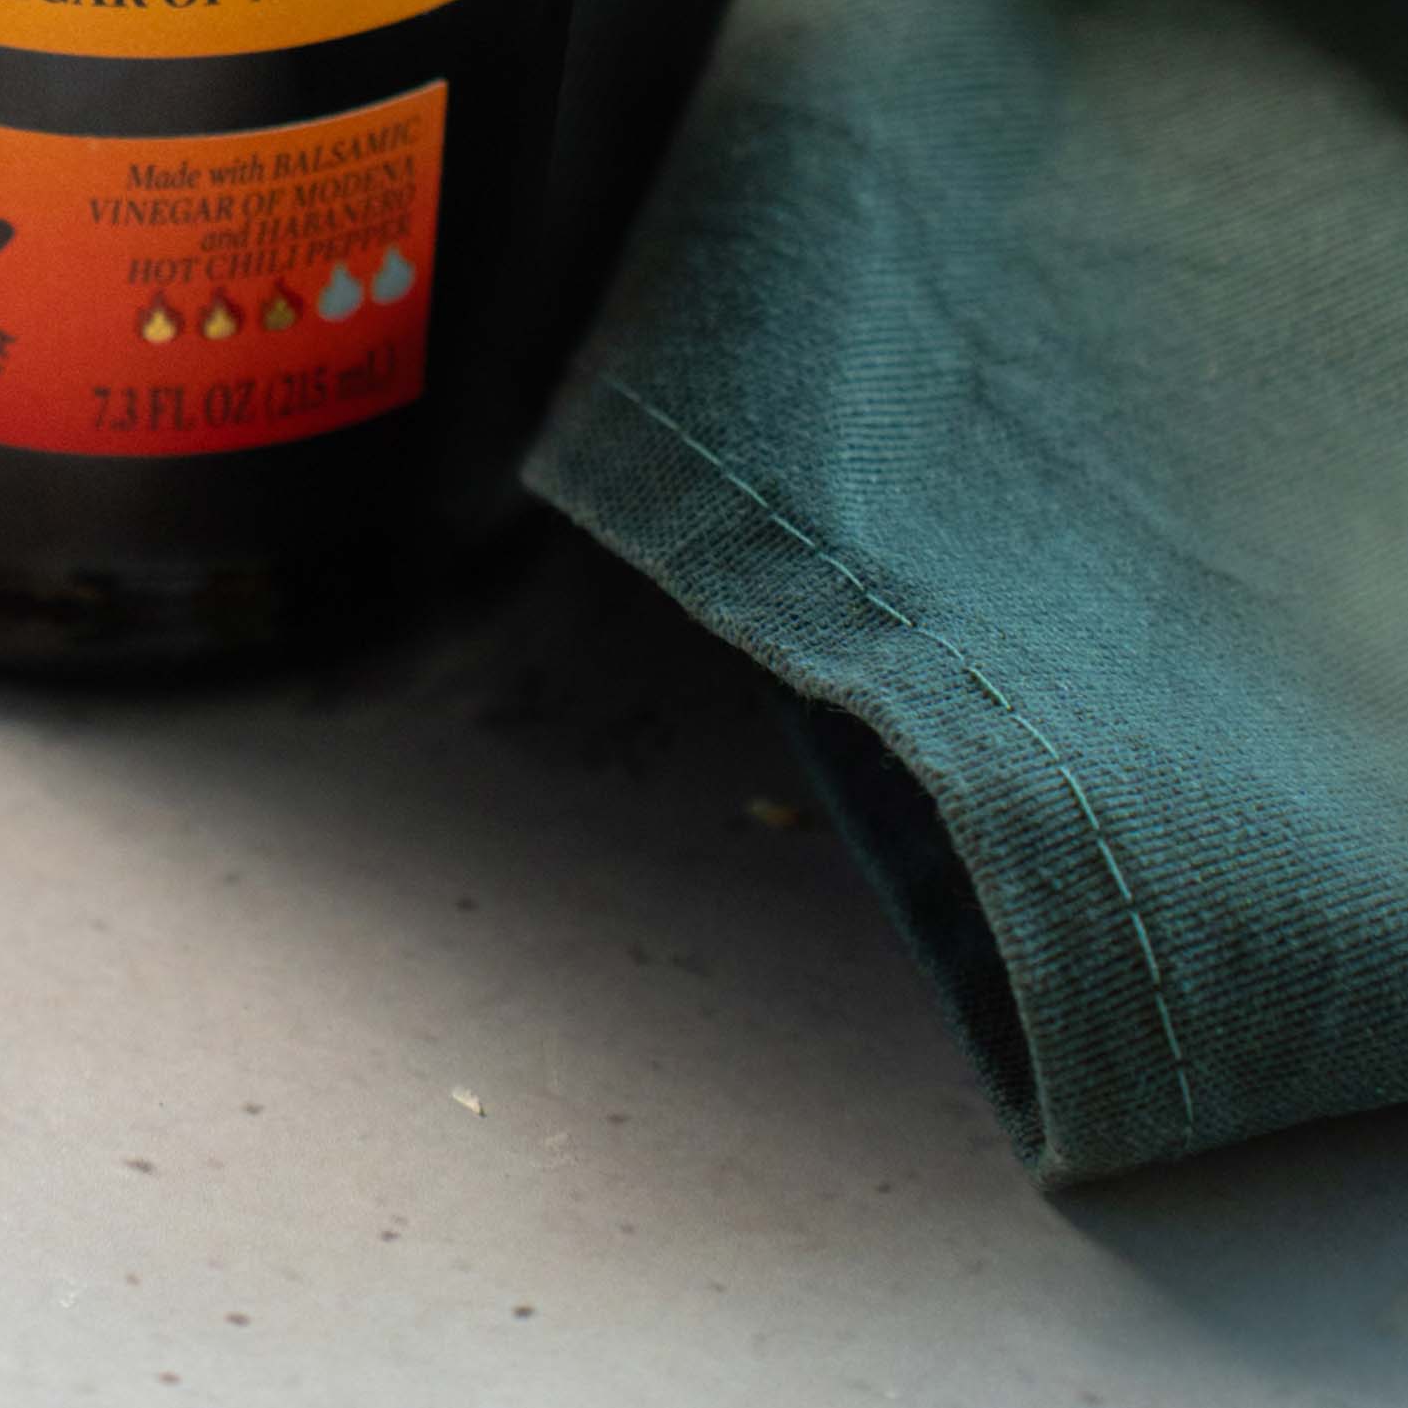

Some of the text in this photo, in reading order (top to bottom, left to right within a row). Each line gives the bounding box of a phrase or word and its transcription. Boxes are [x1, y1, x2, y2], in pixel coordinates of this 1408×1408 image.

[126, 113, 423, 192] Made with BALSAMIC
[87, 154, 416, 226] VINEGAR OF MODENA
[199, 220, 251, 253] and
[126, 257, 200, 286] HOT
[203, 242, 300, 282] CHILI
[203, 377, 257, 429] OZ
